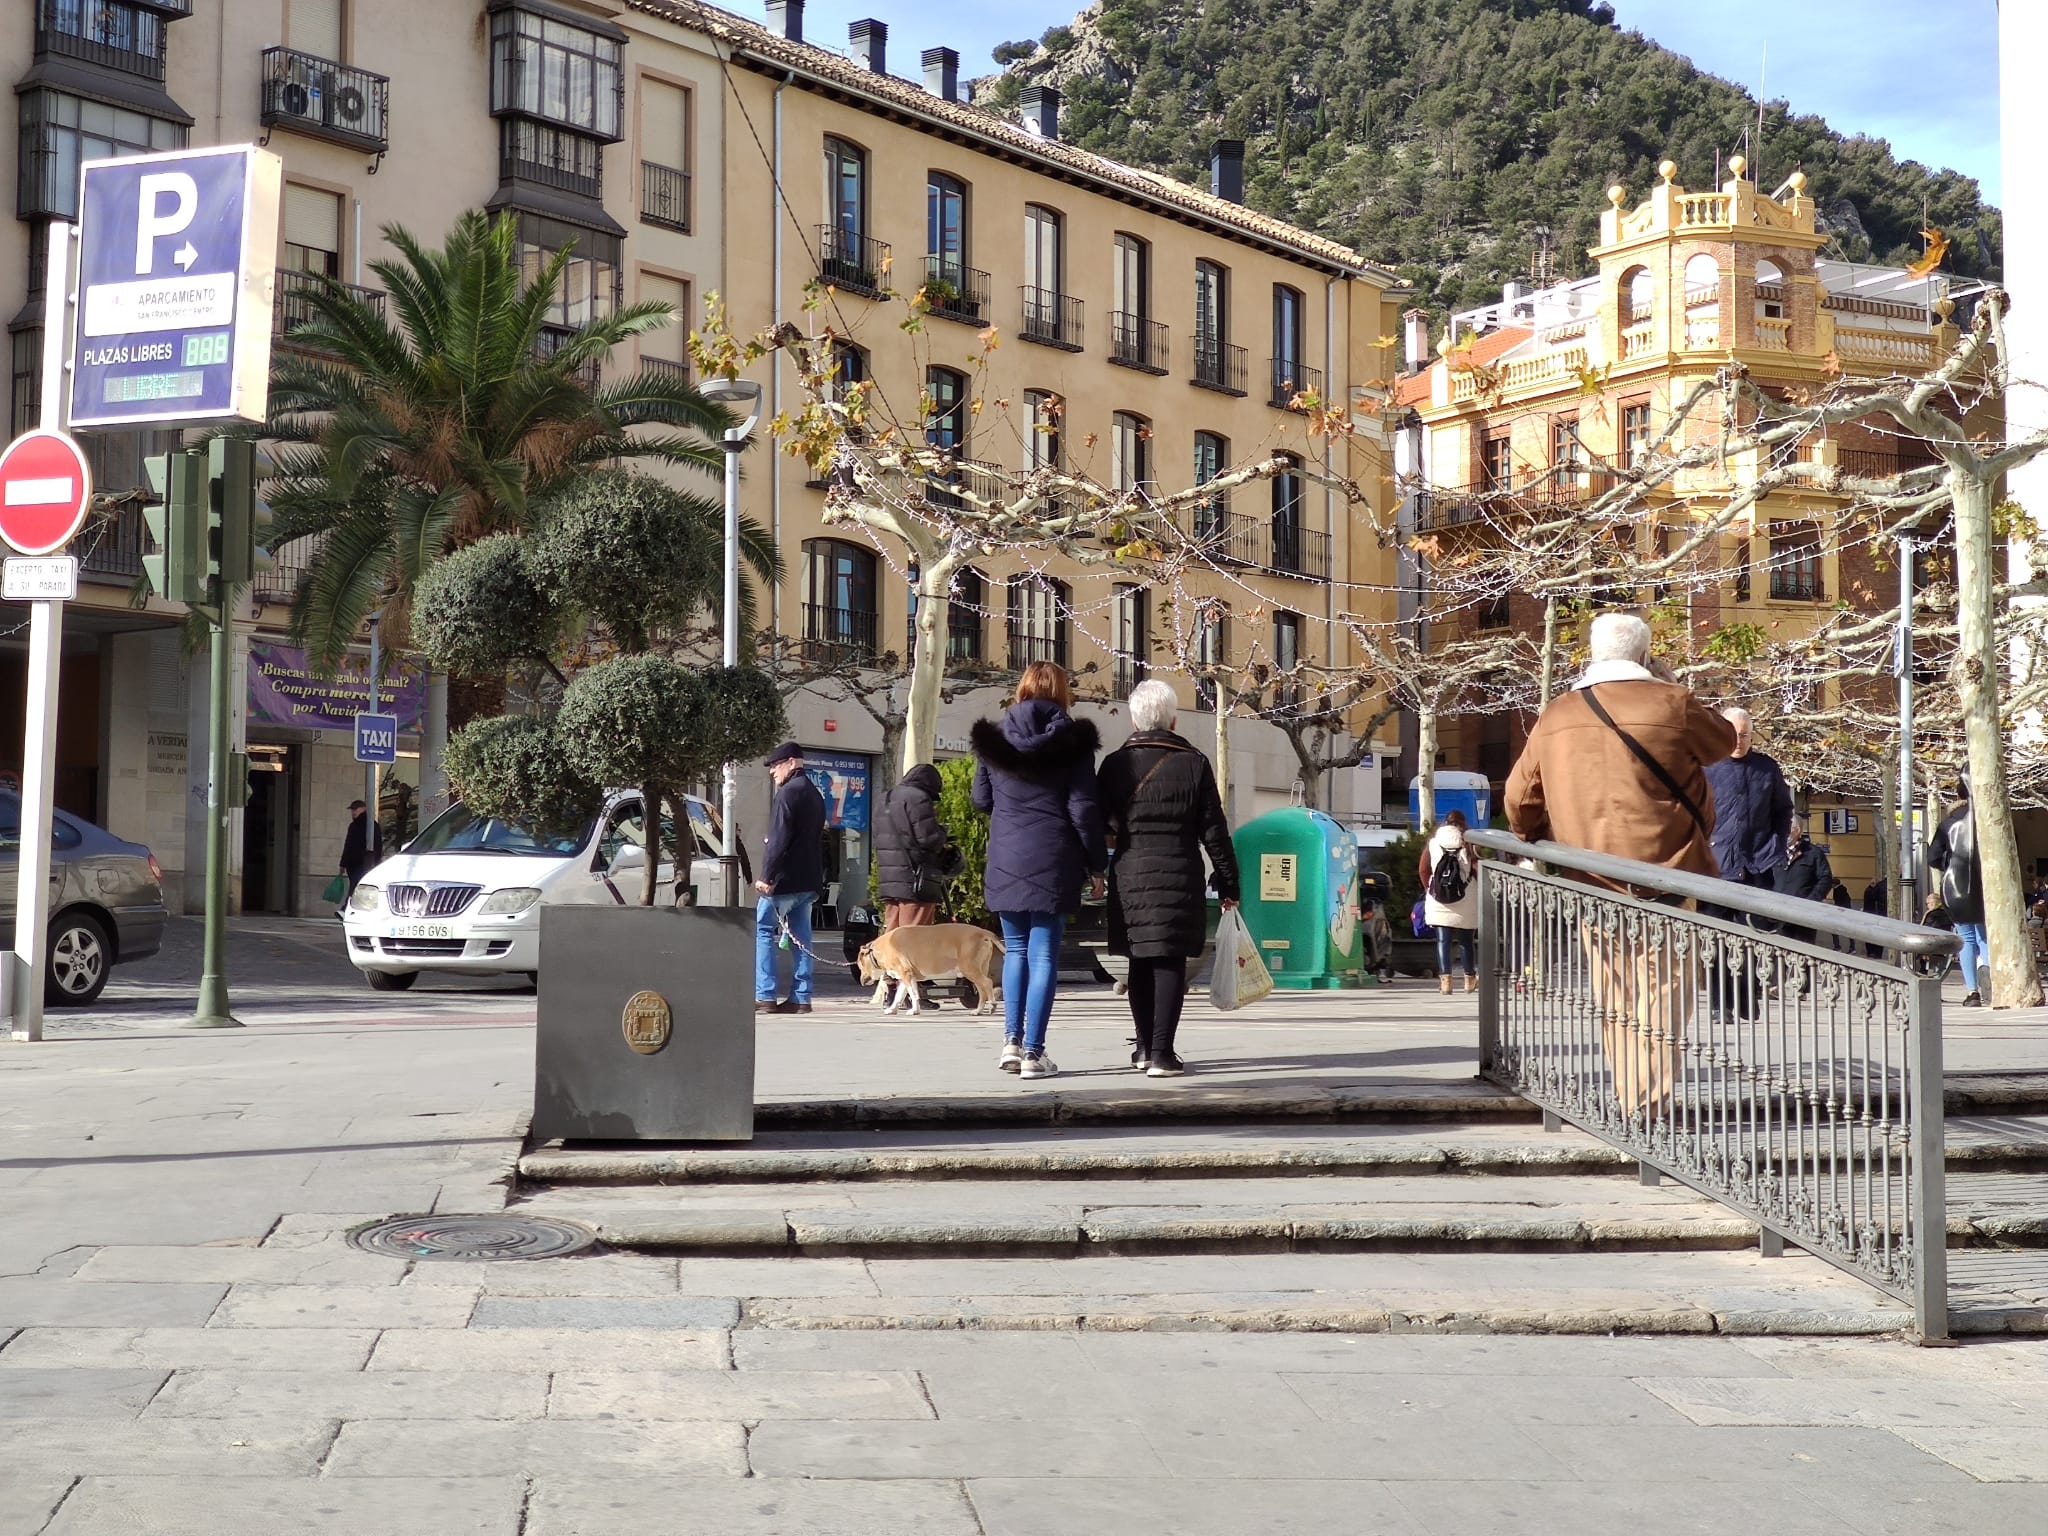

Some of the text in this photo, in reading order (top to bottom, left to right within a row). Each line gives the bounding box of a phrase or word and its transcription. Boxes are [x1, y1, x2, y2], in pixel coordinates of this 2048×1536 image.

[136, 172, 198, 275] P
[139, 288, 216, 305] APARCAMIENTO
[83, 343, 173, 366] PLAZAS LIBRES
[257, 662, 305, 679] ¿Buscas
[272, 679, 327, 699] Compra
[293, 703, 317, 715] por
[361, 729, 392, 748] TAXI
[428, 926, 448, 937] GVS
